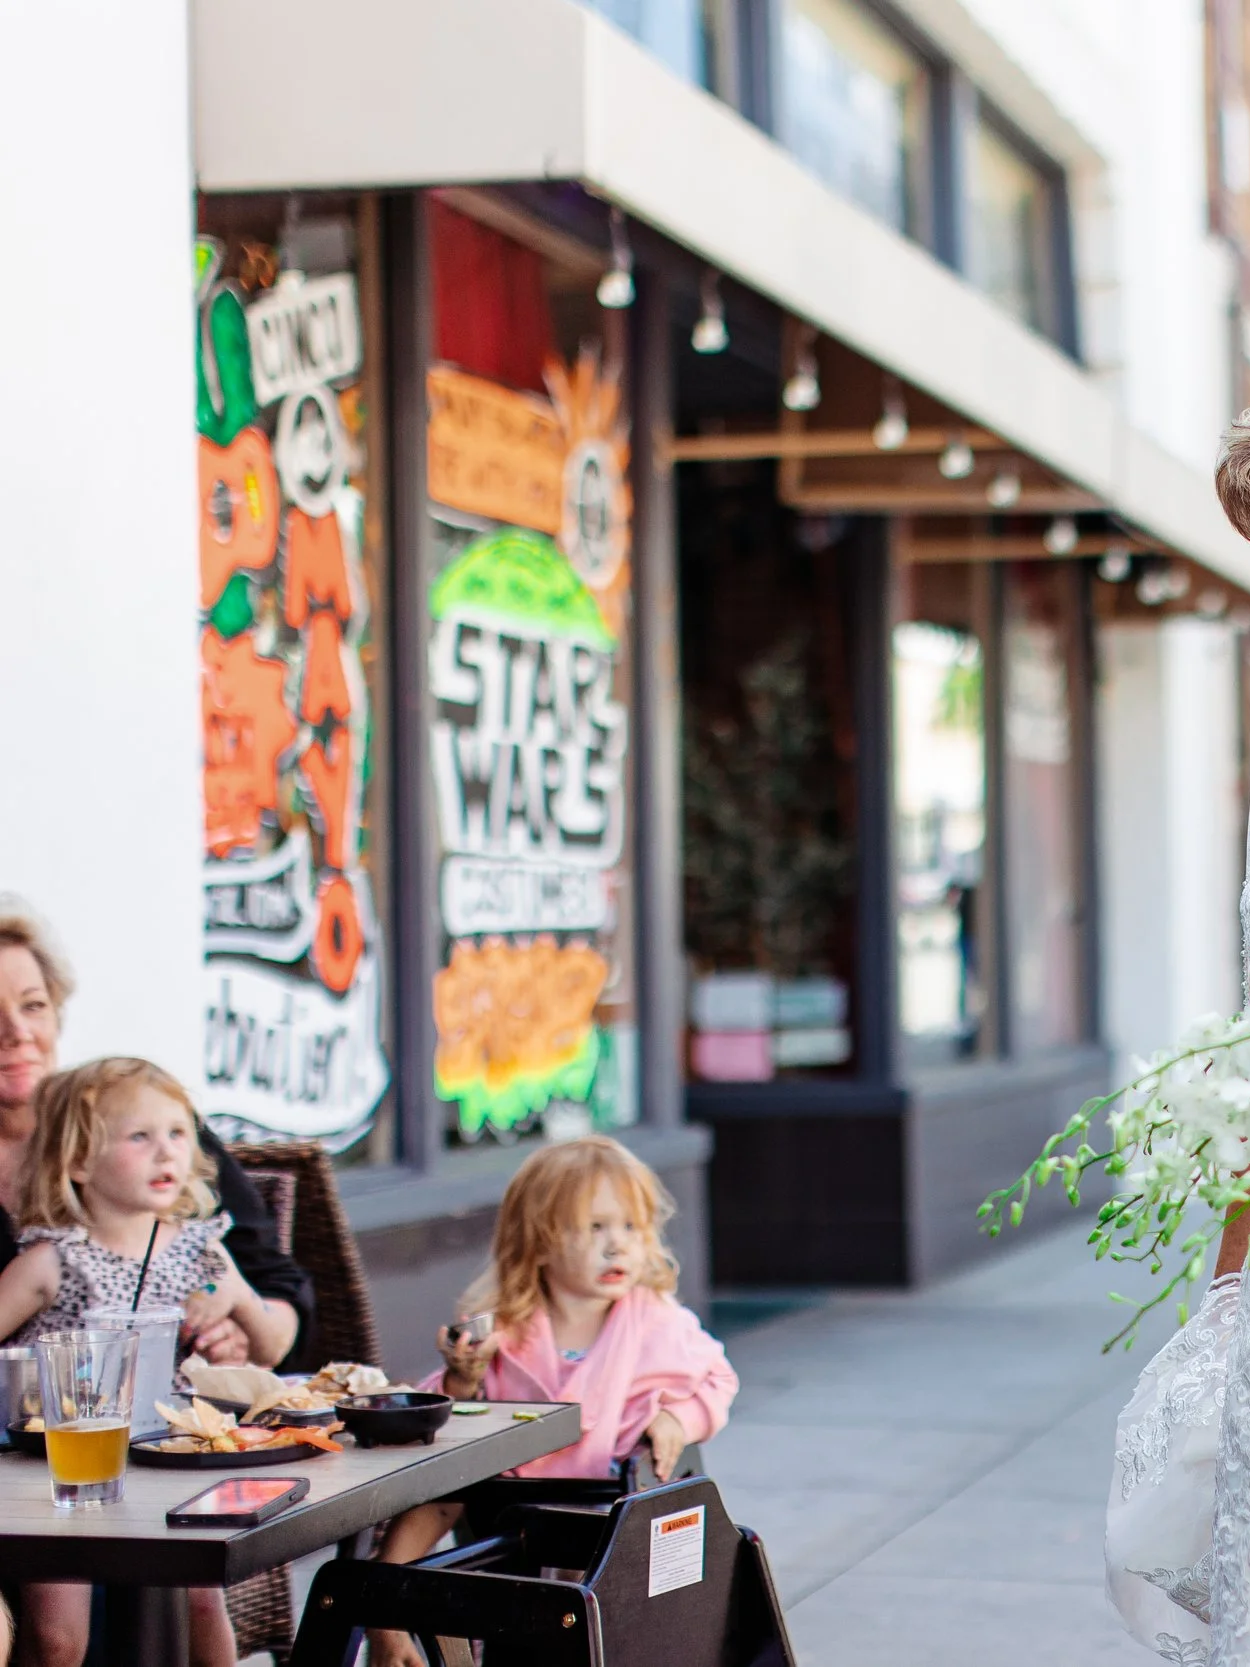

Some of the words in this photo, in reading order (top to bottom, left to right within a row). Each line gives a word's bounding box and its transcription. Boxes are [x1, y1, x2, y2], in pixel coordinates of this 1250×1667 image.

[259, 293, 344, 382] CINCO
[435, 620, 618, 745] STAR
[436, 732, 612, 850] WARS
